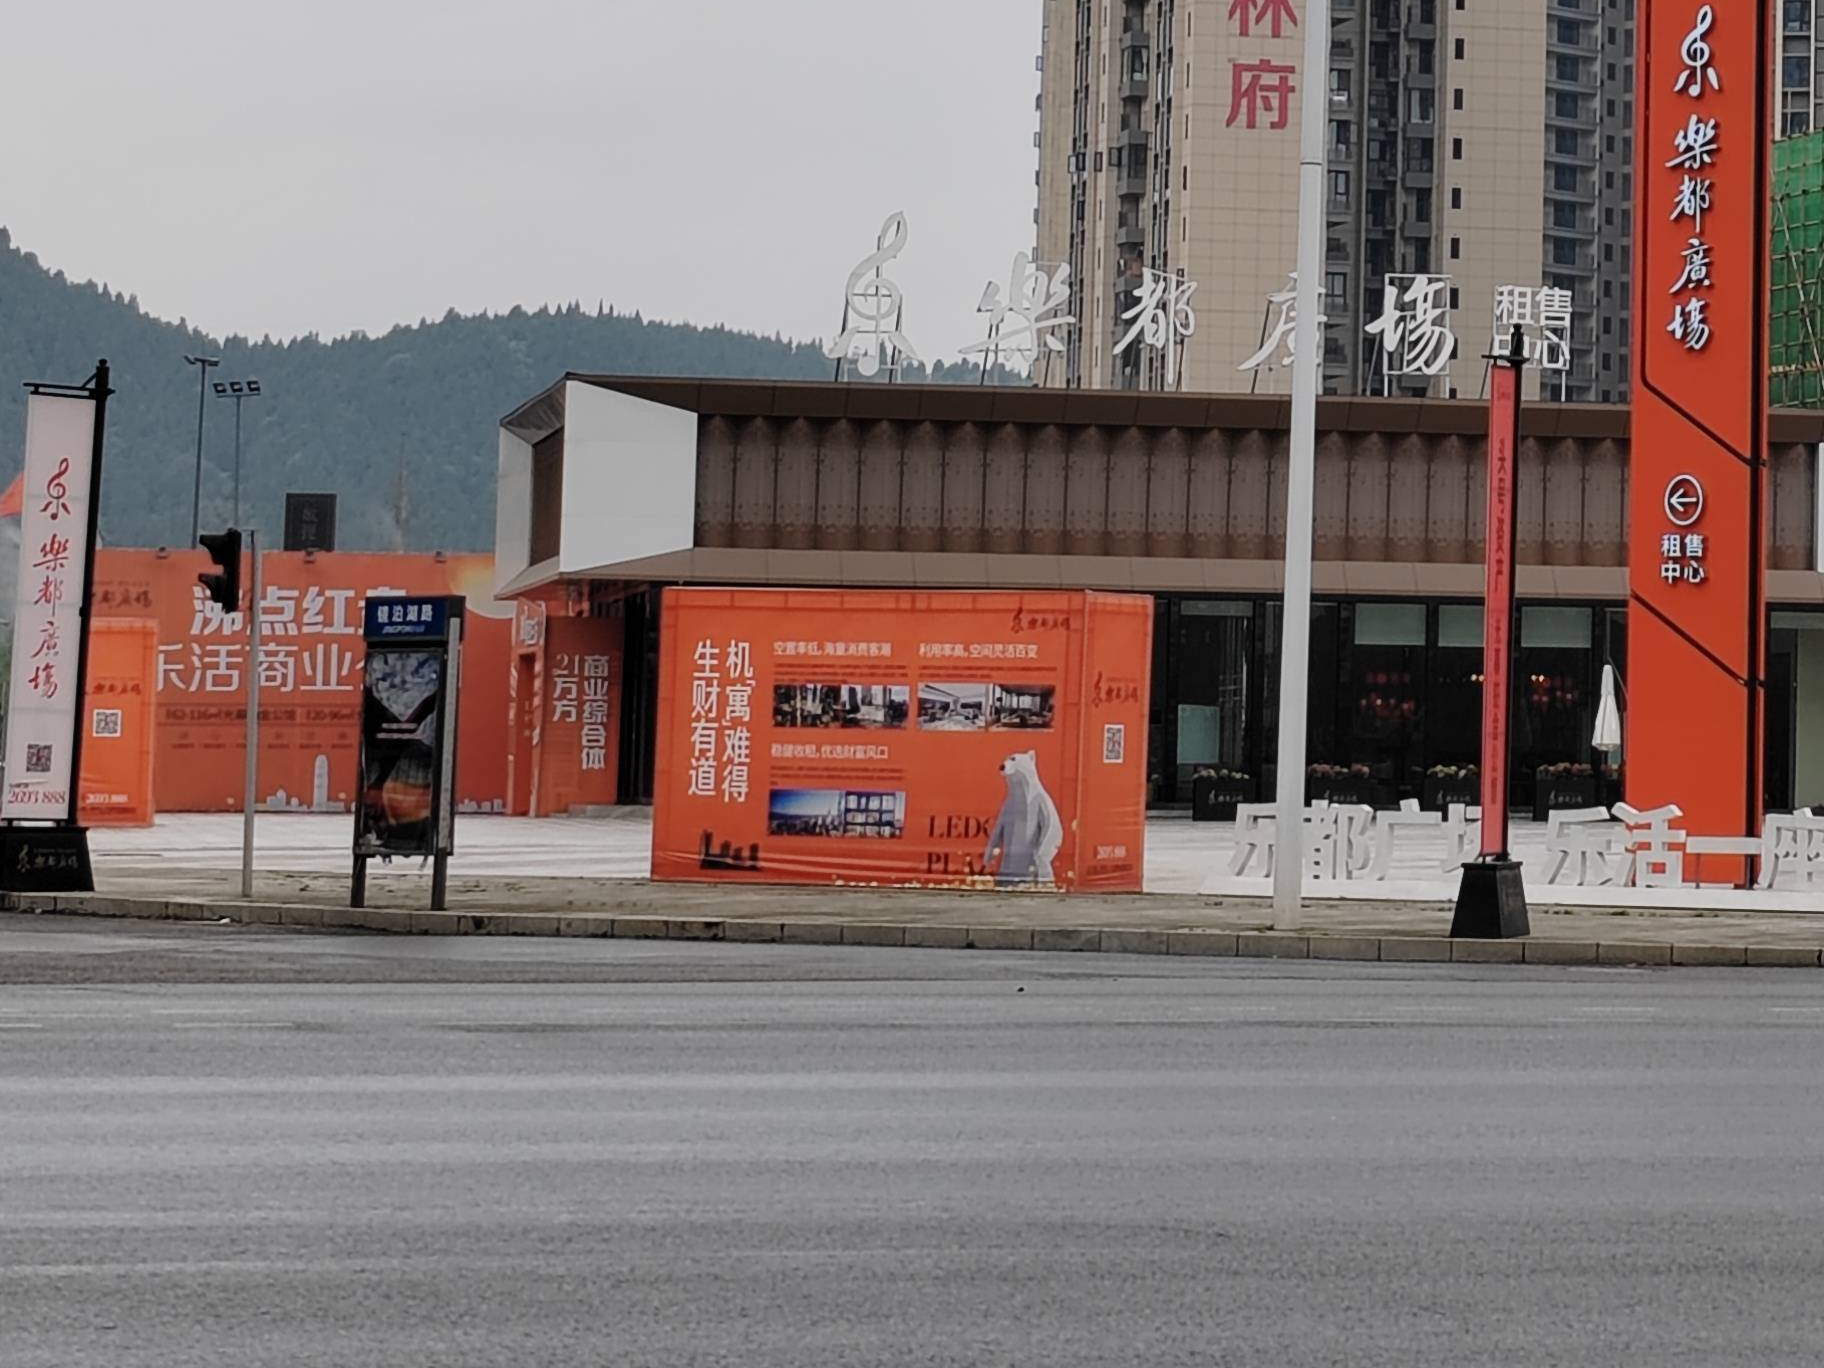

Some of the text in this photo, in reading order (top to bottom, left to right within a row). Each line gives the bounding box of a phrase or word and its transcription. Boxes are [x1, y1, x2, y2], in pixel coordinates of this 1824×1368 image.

[1494, 285, 1573, 327] 租售
[1661, 534, 1704, 557] 租售
[1661, 560, 1705, 584] 中心
[190, 585, 407, 636] 沸点红
[581, 655, 609, 770] 商业综合体
[688, 639, 720, 796] 生财有道
